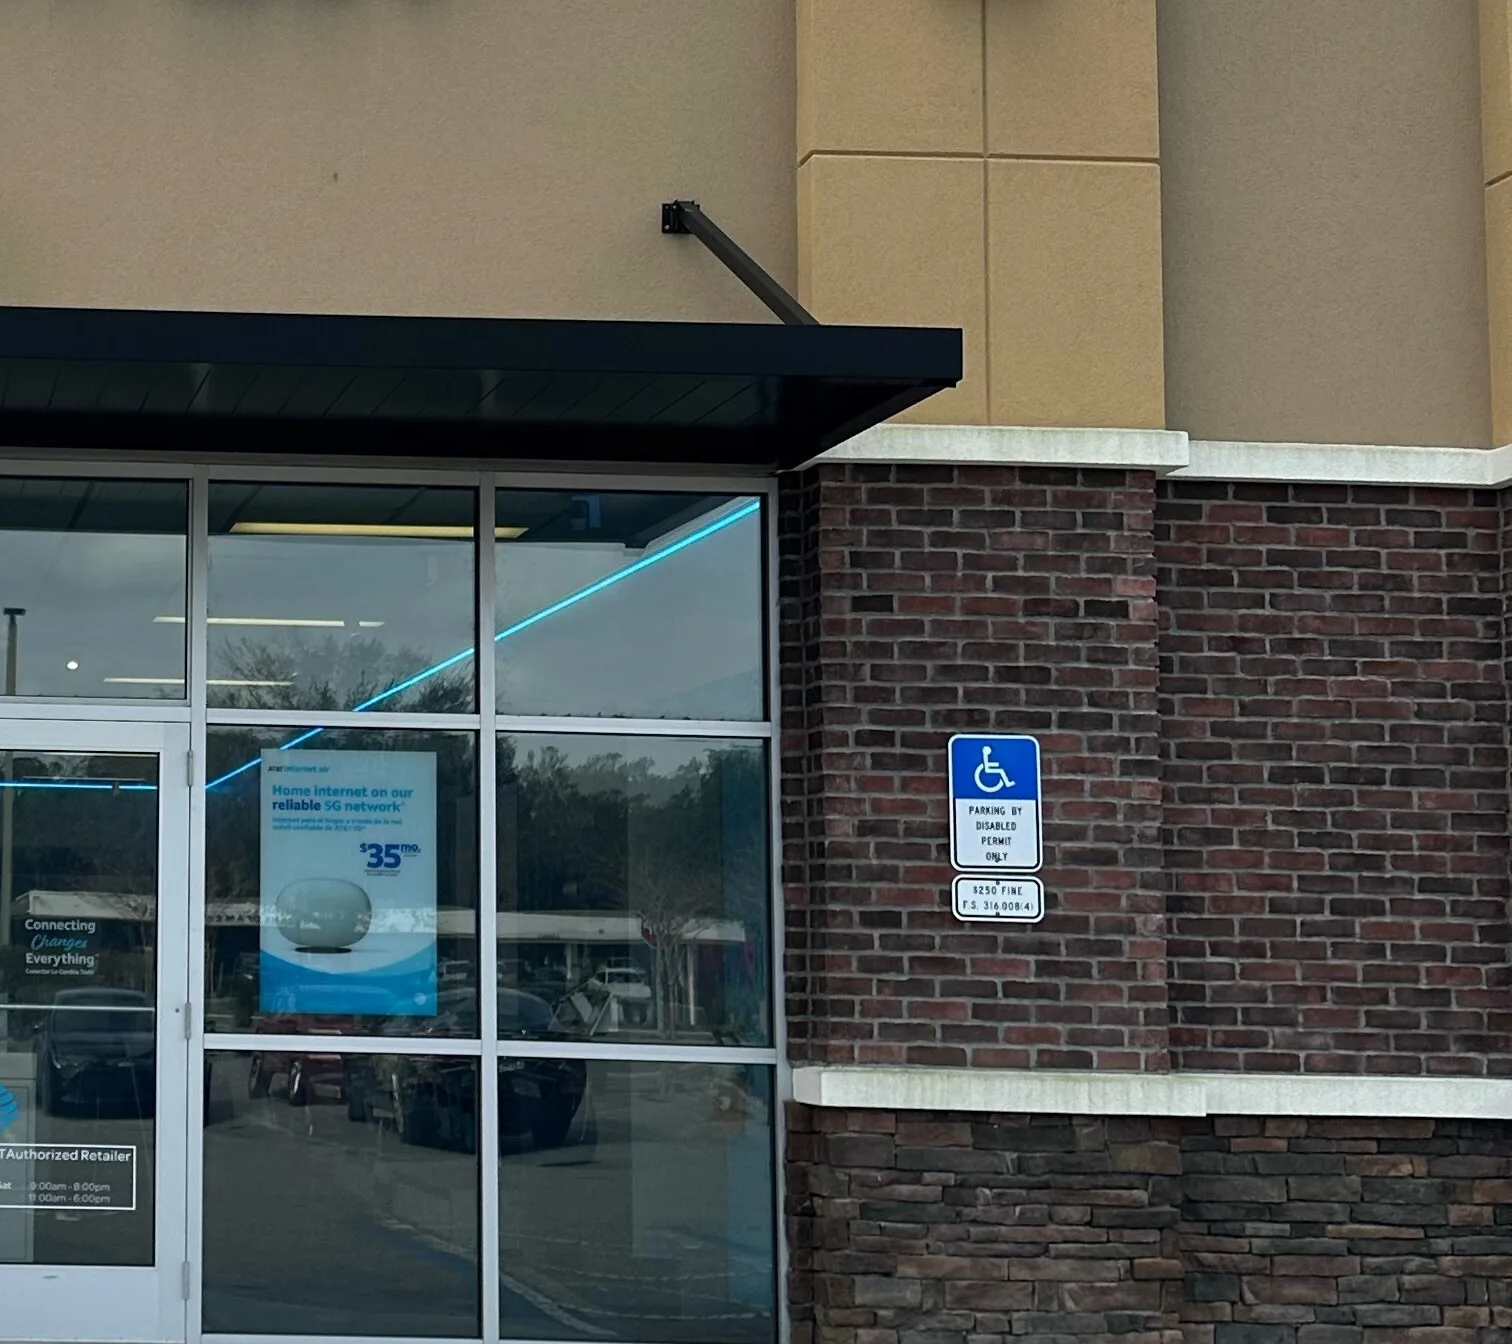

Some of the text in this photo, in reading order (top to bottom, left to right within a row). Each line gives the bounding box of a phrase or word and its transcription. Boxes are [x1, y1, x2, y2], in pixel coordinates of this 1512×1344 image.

[272, 785, 311, 797] Home
[371, 787, 388, 798] on
[391, 788, 414, 799] our
[272, 798, 321, 811] reliable
[324, 800, 342, 811] 5G
[968, 805, 1022, 816] PARKING BY
[976, 821, 1016, 831] DISABLED
[981, 837, 1011, 845] PERMIT
[360, 842, 401, 869] $35
[986, 852, 1008, 862] ONLY
[973, 886, 1023, 896] $250 FINE
[25, 919, 96, 934] Connecting
[31, 933, 88, 951] Changes
[6, 1149, 78, 1161] Authorized
[81, 1150, 131, 1162] Retailer
